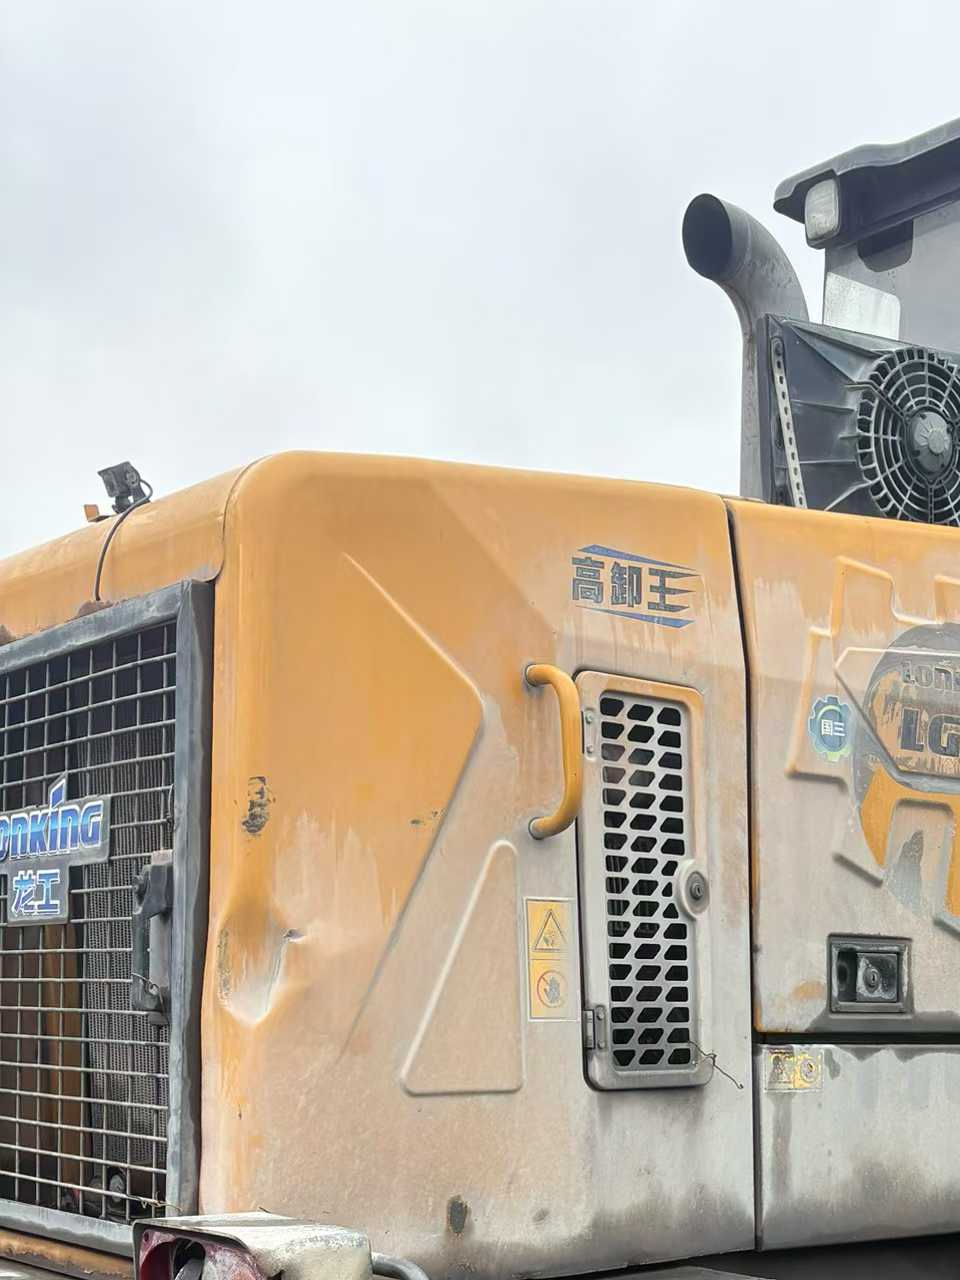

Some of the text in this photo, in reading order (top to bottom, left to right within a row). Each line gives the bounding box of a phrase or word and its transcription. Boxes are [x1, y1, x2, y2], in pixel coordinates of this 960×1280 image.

[571, 556, 701, 613] 高卸王
[11, 869, 60, 916] 龙工
